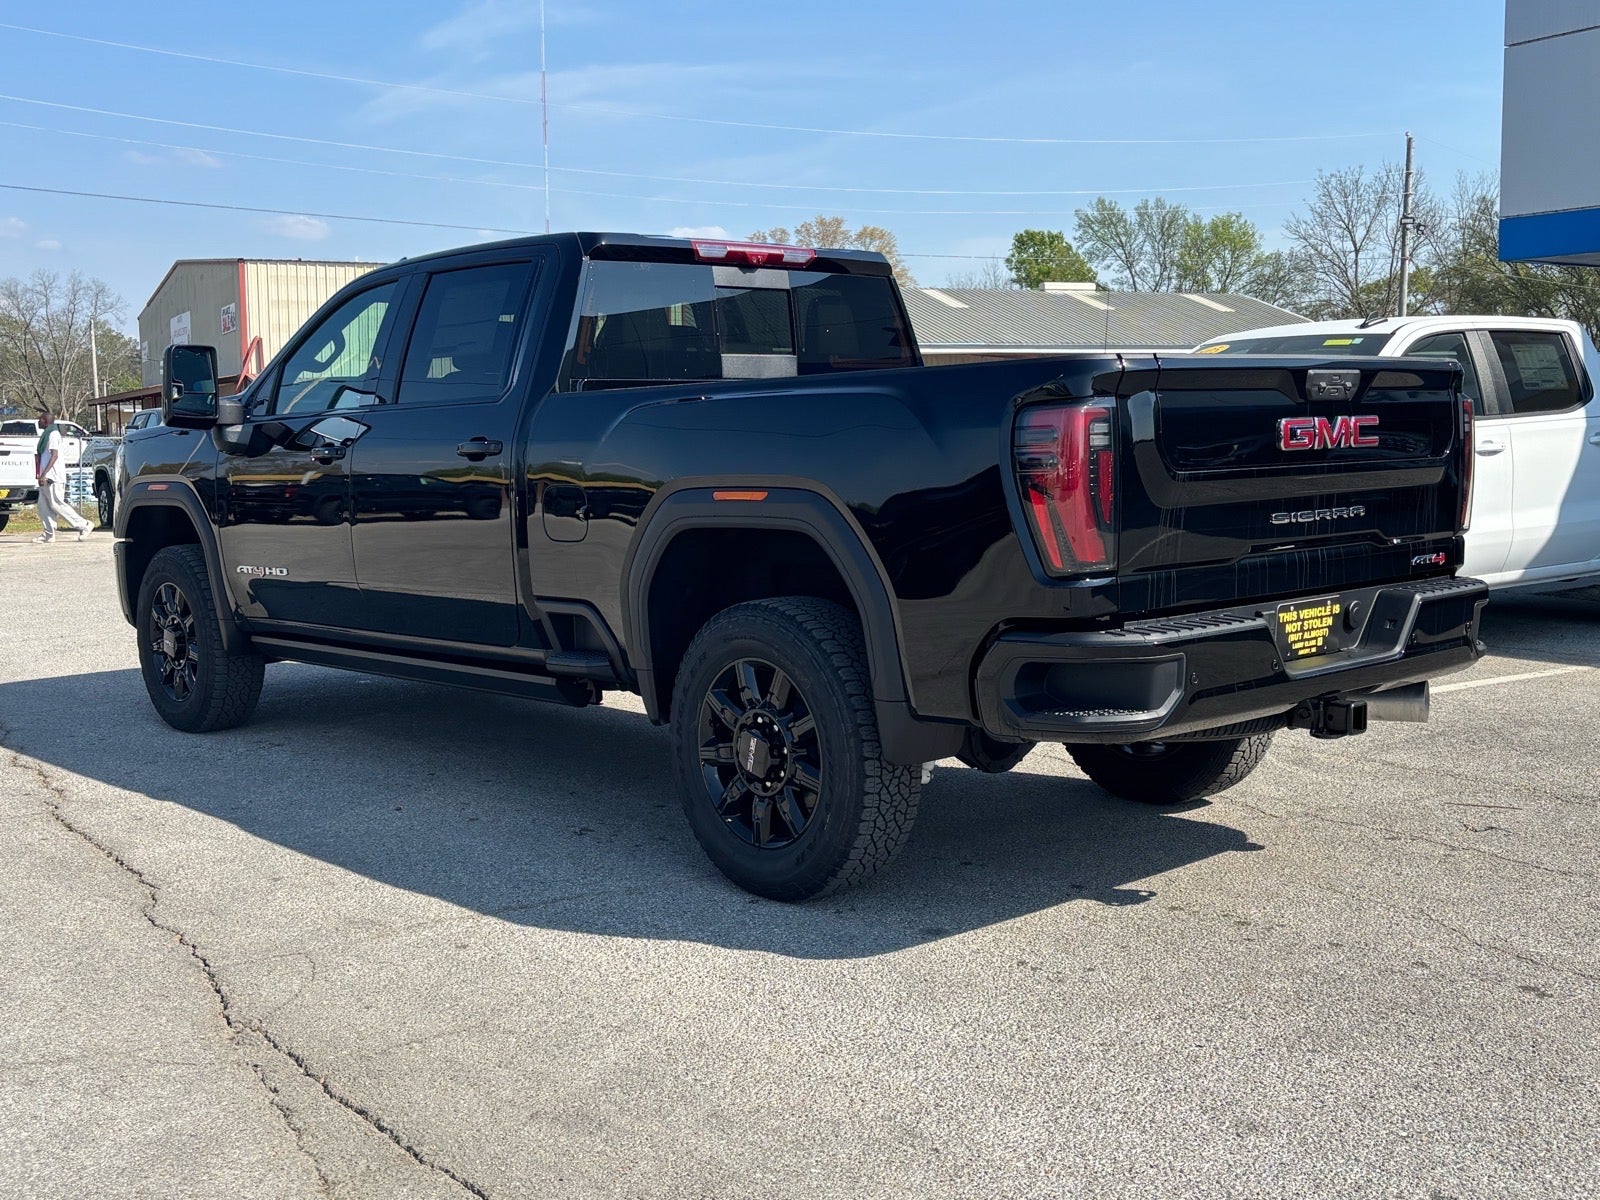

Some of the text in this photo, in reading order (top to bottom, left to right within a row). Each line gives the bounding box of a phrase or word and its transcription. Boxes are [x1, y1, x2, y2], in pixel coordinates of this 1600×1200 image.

[1276, 414, 1380, 451] GMC
[1269, 505, 1366, 525] SIERRA
[1411, 552, 1446, 566] AT4
[1279, 604, 1340, 623] THIS VEHICLE IS
[1286, 616, 1332, 633] NOT STOLEN
[1303, 628, 1328, 639] ALMOST)
